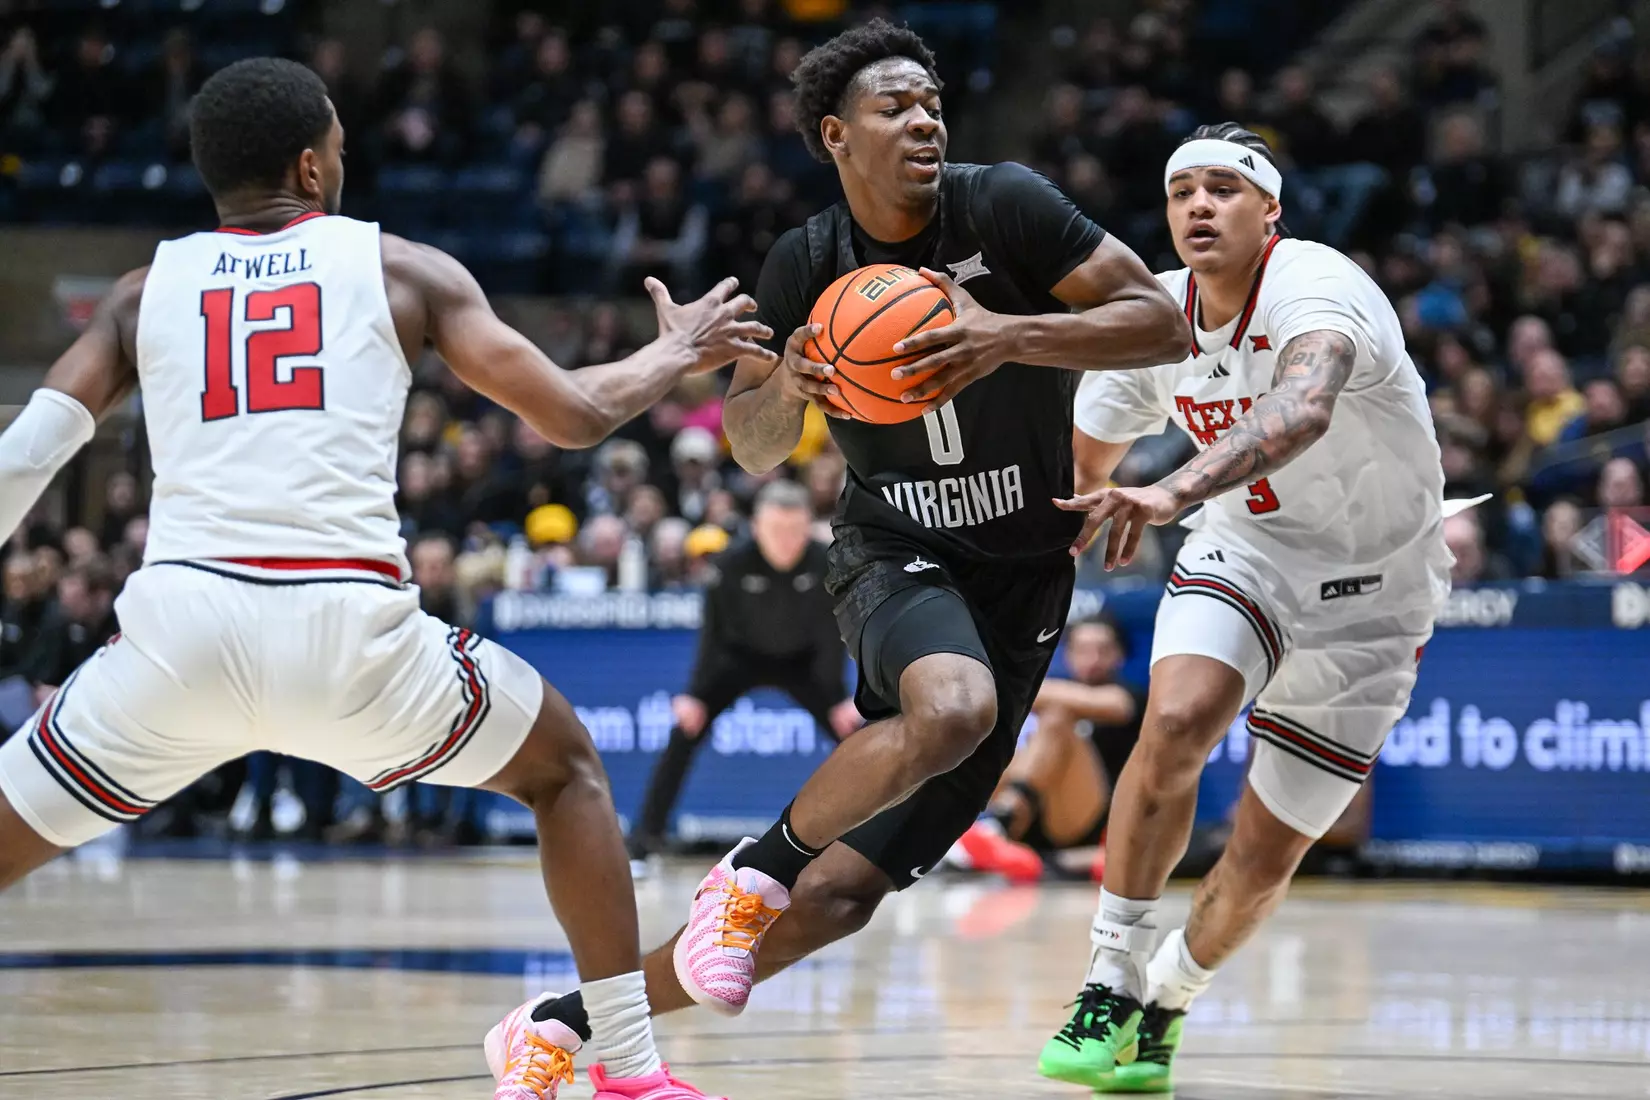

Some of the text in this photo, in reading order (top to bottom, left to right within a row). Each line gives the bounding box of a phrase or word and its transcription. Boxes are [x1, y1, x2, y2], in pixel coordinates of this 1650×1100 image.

[210, 248, 312, 279] ATWELL
[199, 281, 325, 422] 12
[922, 399, 965, 466] 0
[881, 464, 1025, 529] VIRGINIA
[1246, 477, 1281, 515] 3
[1457, 703, 1518, 770] to
